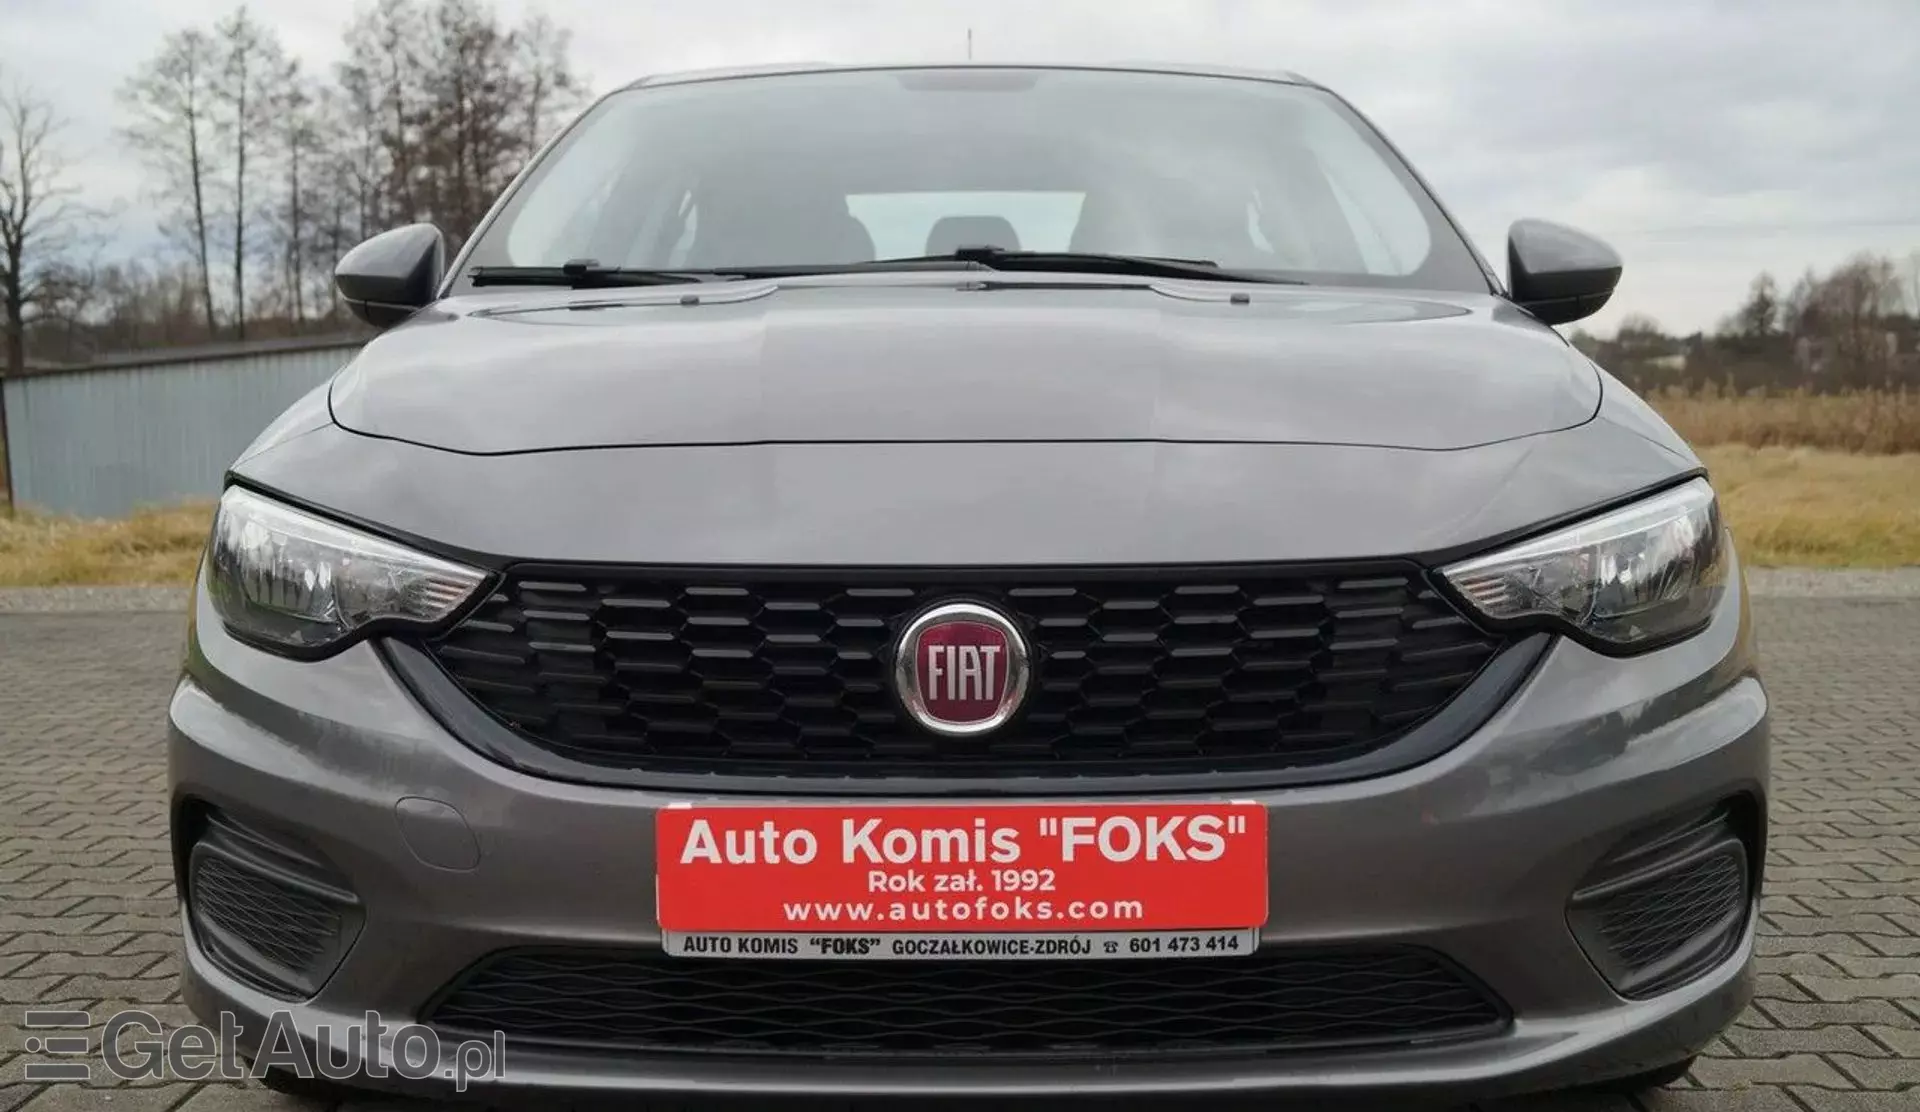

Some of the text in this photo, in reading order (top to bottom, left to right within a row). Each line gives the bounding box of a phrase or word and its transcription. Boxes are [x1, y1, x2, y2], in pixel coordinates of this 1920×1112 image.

[928, 645, 1000, 700] FIAT
[680, 815, 1246, 864] Auto Komis "FOKS"
[868, 869, 1056, 893] Rok zał. 1992
[783, 896, 1143, 921] www.autofoks.com
[684, 936, 732, 953] AUTO
[738, 937, 798, 954] KOMIS
[892, 935, 1091, 956] GOCZAŁKOWICE-ZDRÓJ
[1129, 937, 1161, 953] 601
[1167, 936, 1200, 952] 473
[1206, 935, 1239, 951] 414
